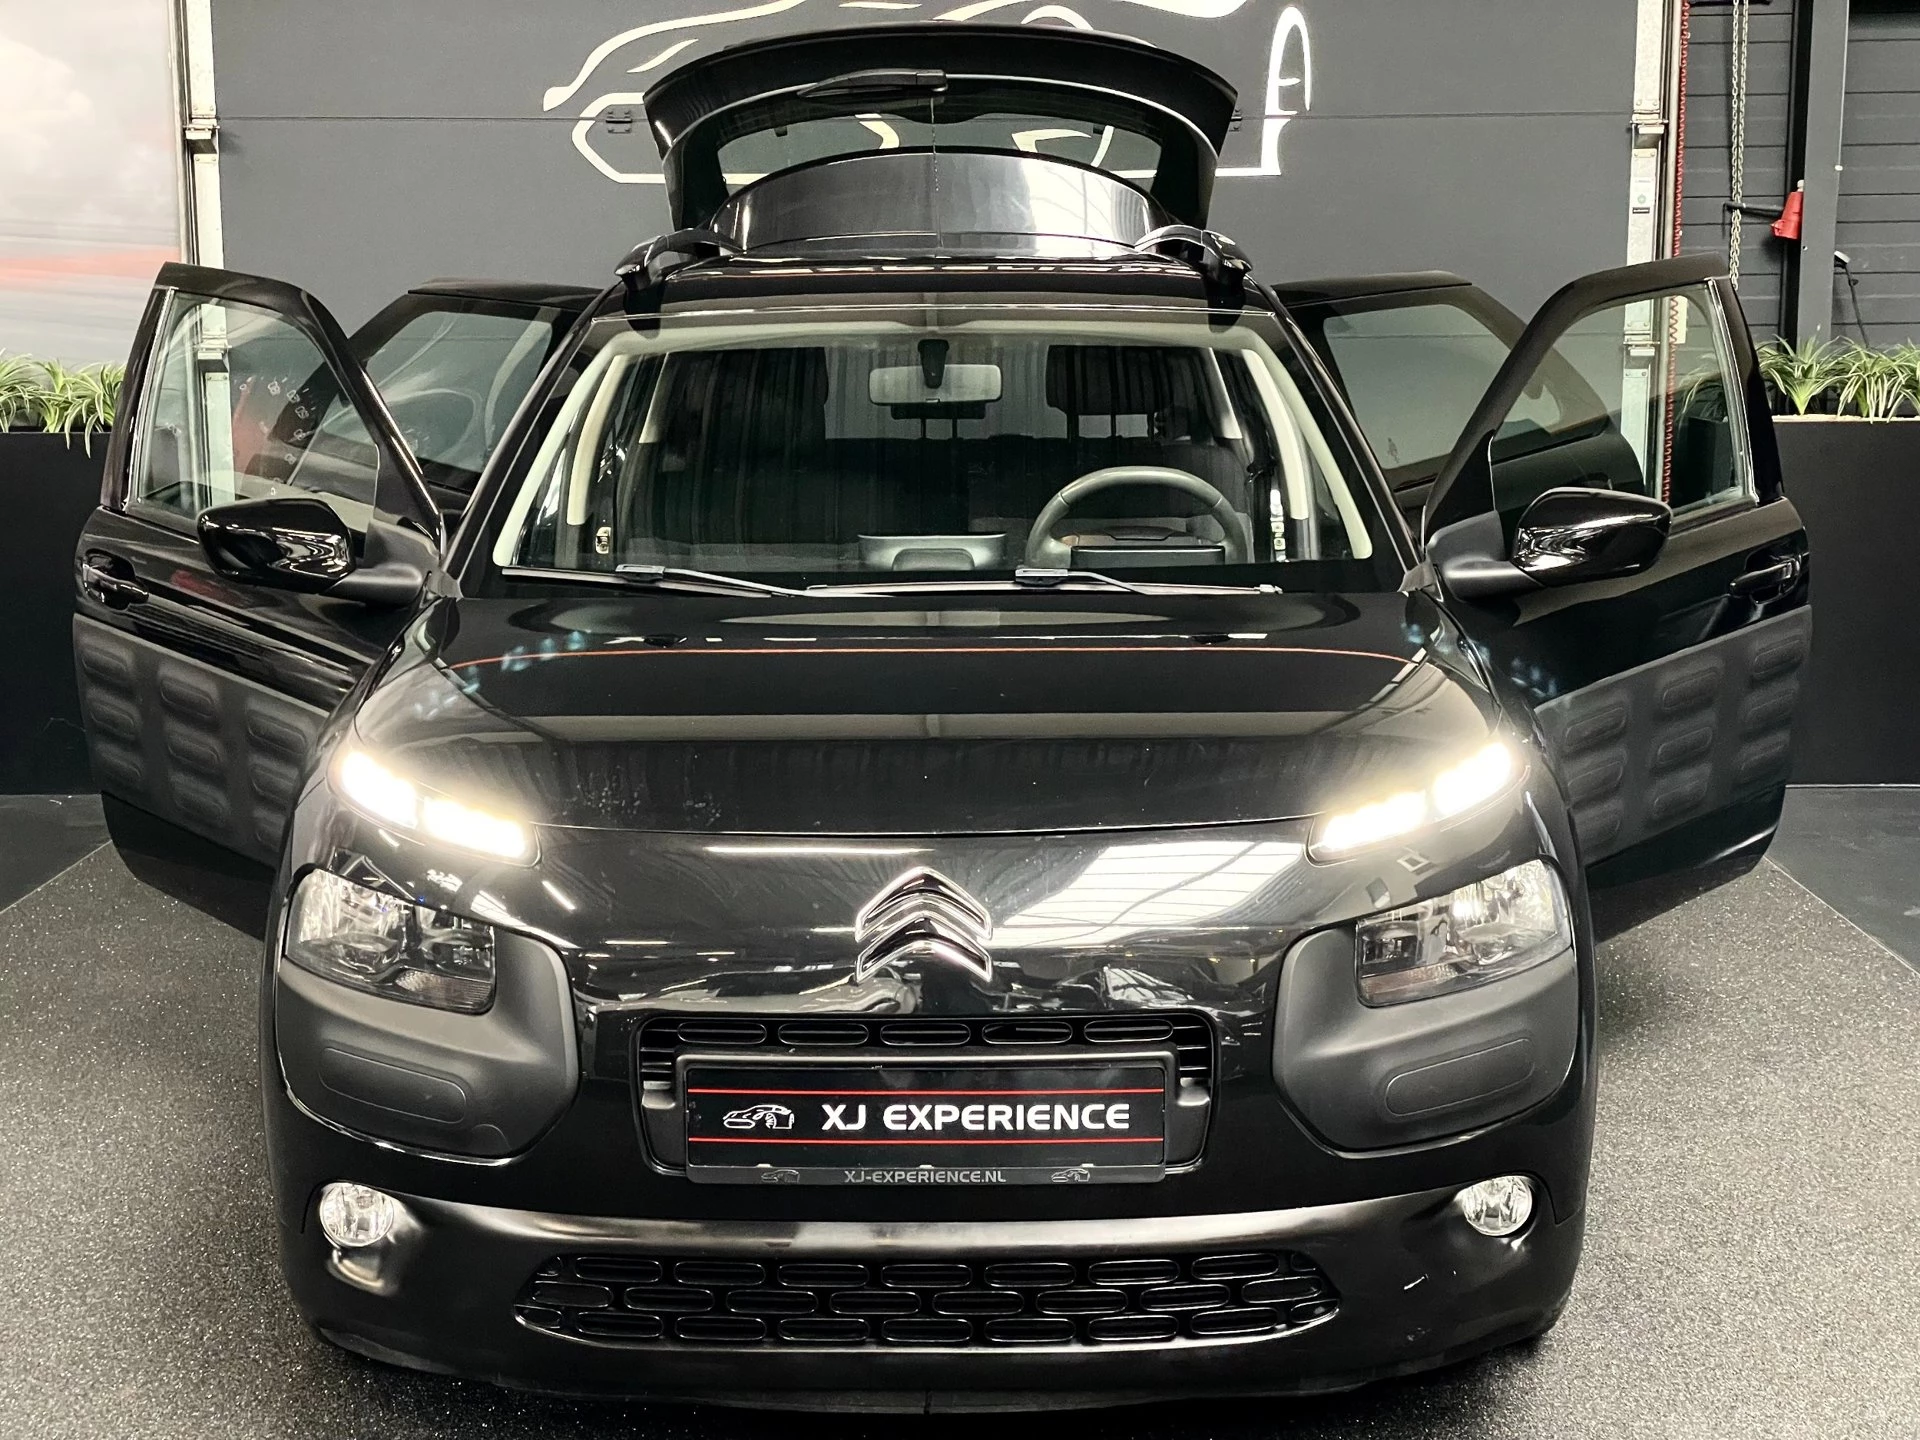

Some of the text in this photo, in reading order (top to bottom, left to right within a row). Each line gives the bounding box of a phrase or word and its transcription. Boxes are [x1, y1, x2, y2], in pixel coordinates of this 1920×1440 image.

[821, 1103, 1130, 1131] XJ EXPERIENCE
[844, 1170, 1007, 1183] XJ-EXPERIENCE.NL
